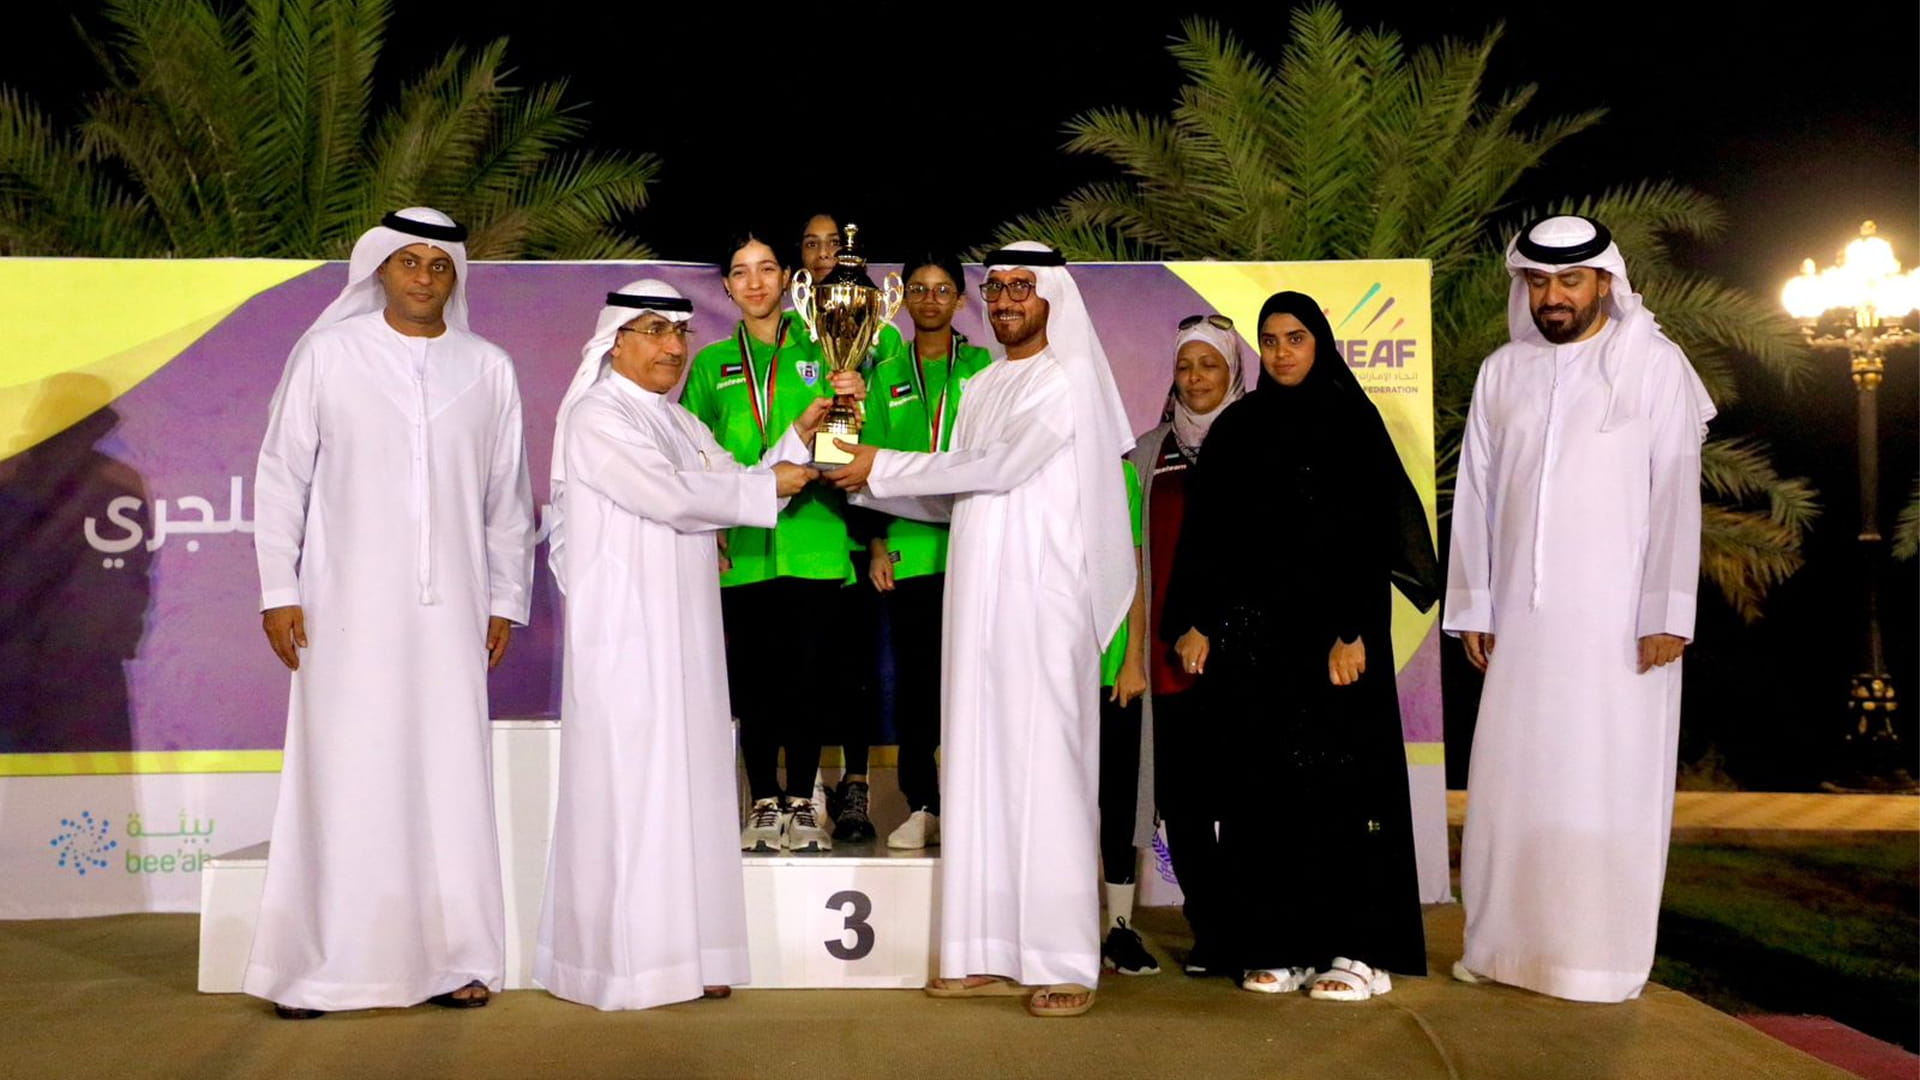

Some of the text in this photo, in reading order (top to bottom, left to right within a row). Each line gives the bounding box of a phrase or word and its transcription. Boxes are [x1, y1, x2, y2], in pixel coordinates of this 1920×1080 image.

[83, 476, 255, 568] لجري
[126, 809, 215, 844] بيئة
[824, 890, 875, 961] 3
